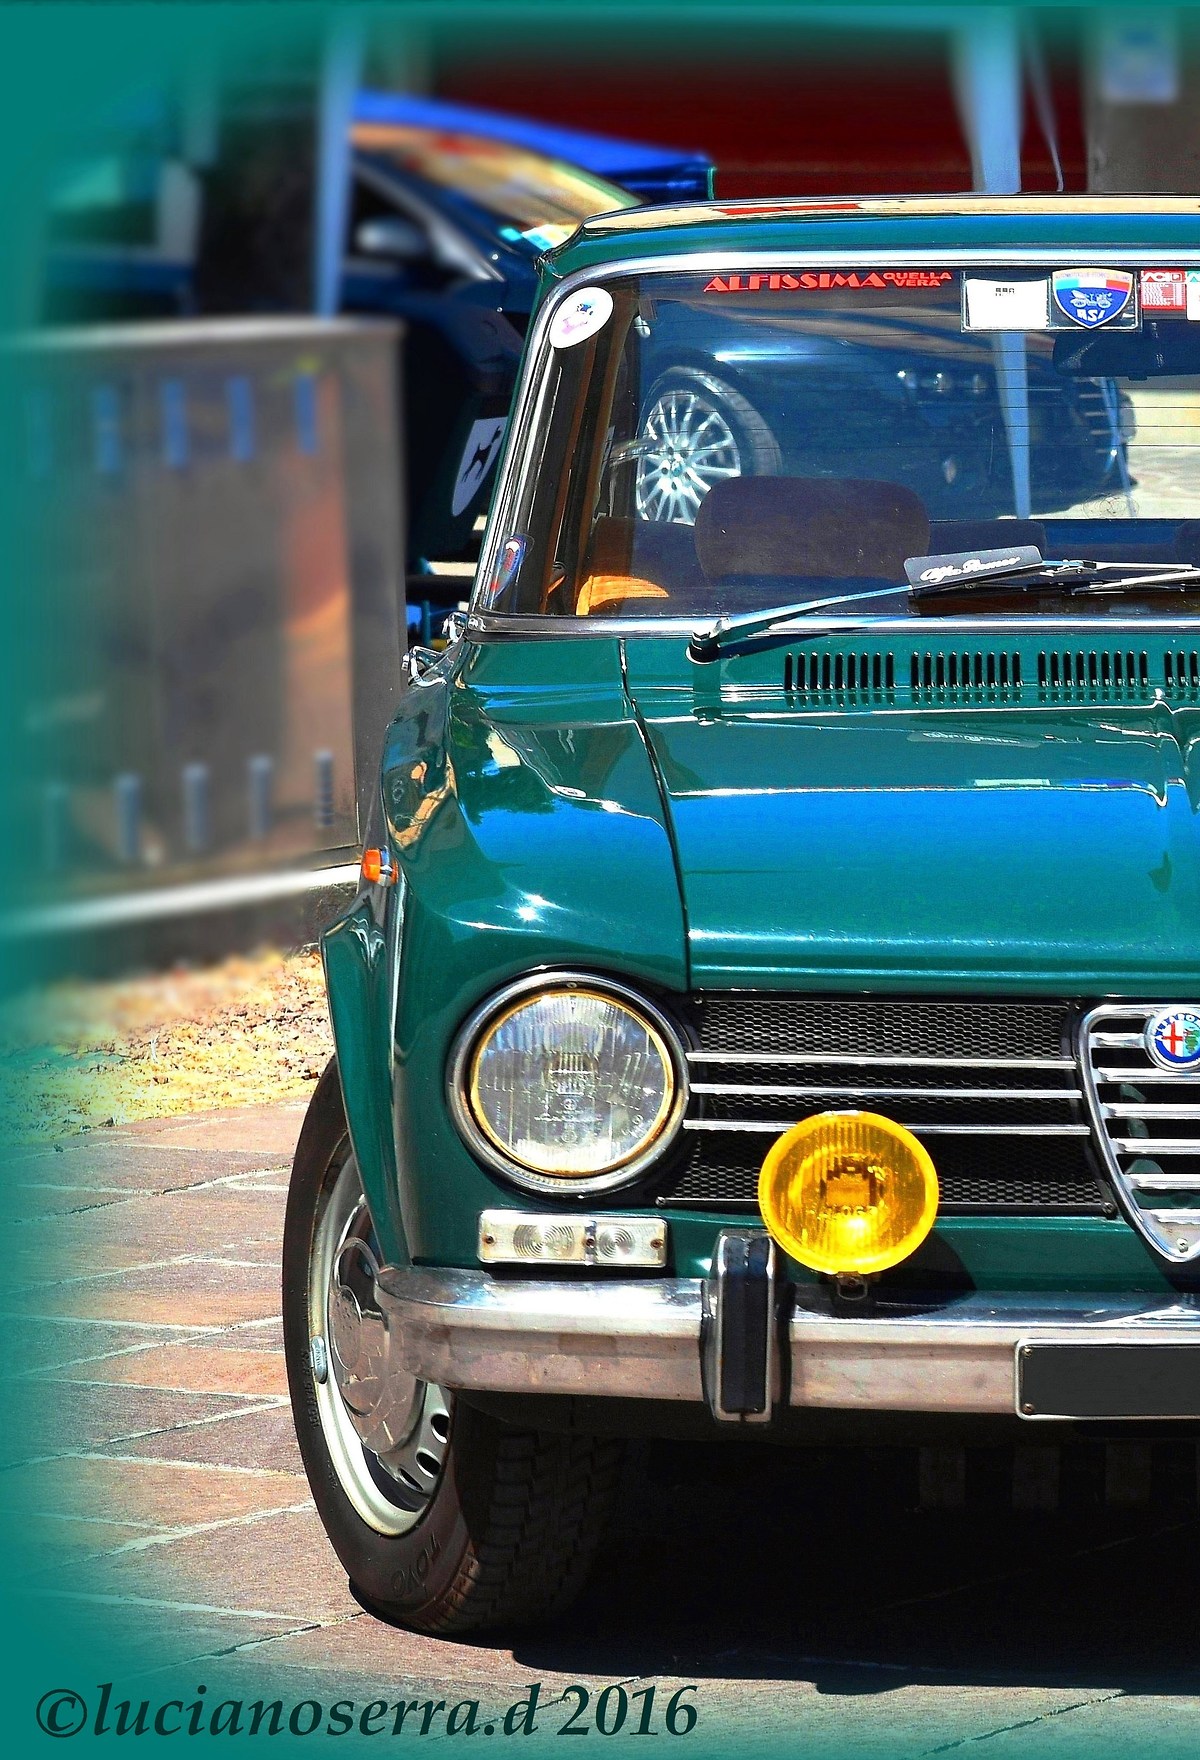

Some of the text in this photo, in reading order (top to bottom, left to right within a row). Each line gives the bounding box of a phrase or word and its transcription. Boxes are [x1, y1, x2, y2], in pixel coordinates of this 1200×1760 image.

[882, 270, 952, 280] QUELLA
[703, 272, 887, 293] ALFISSIMA
[894, 279, 942, 287] VERA
